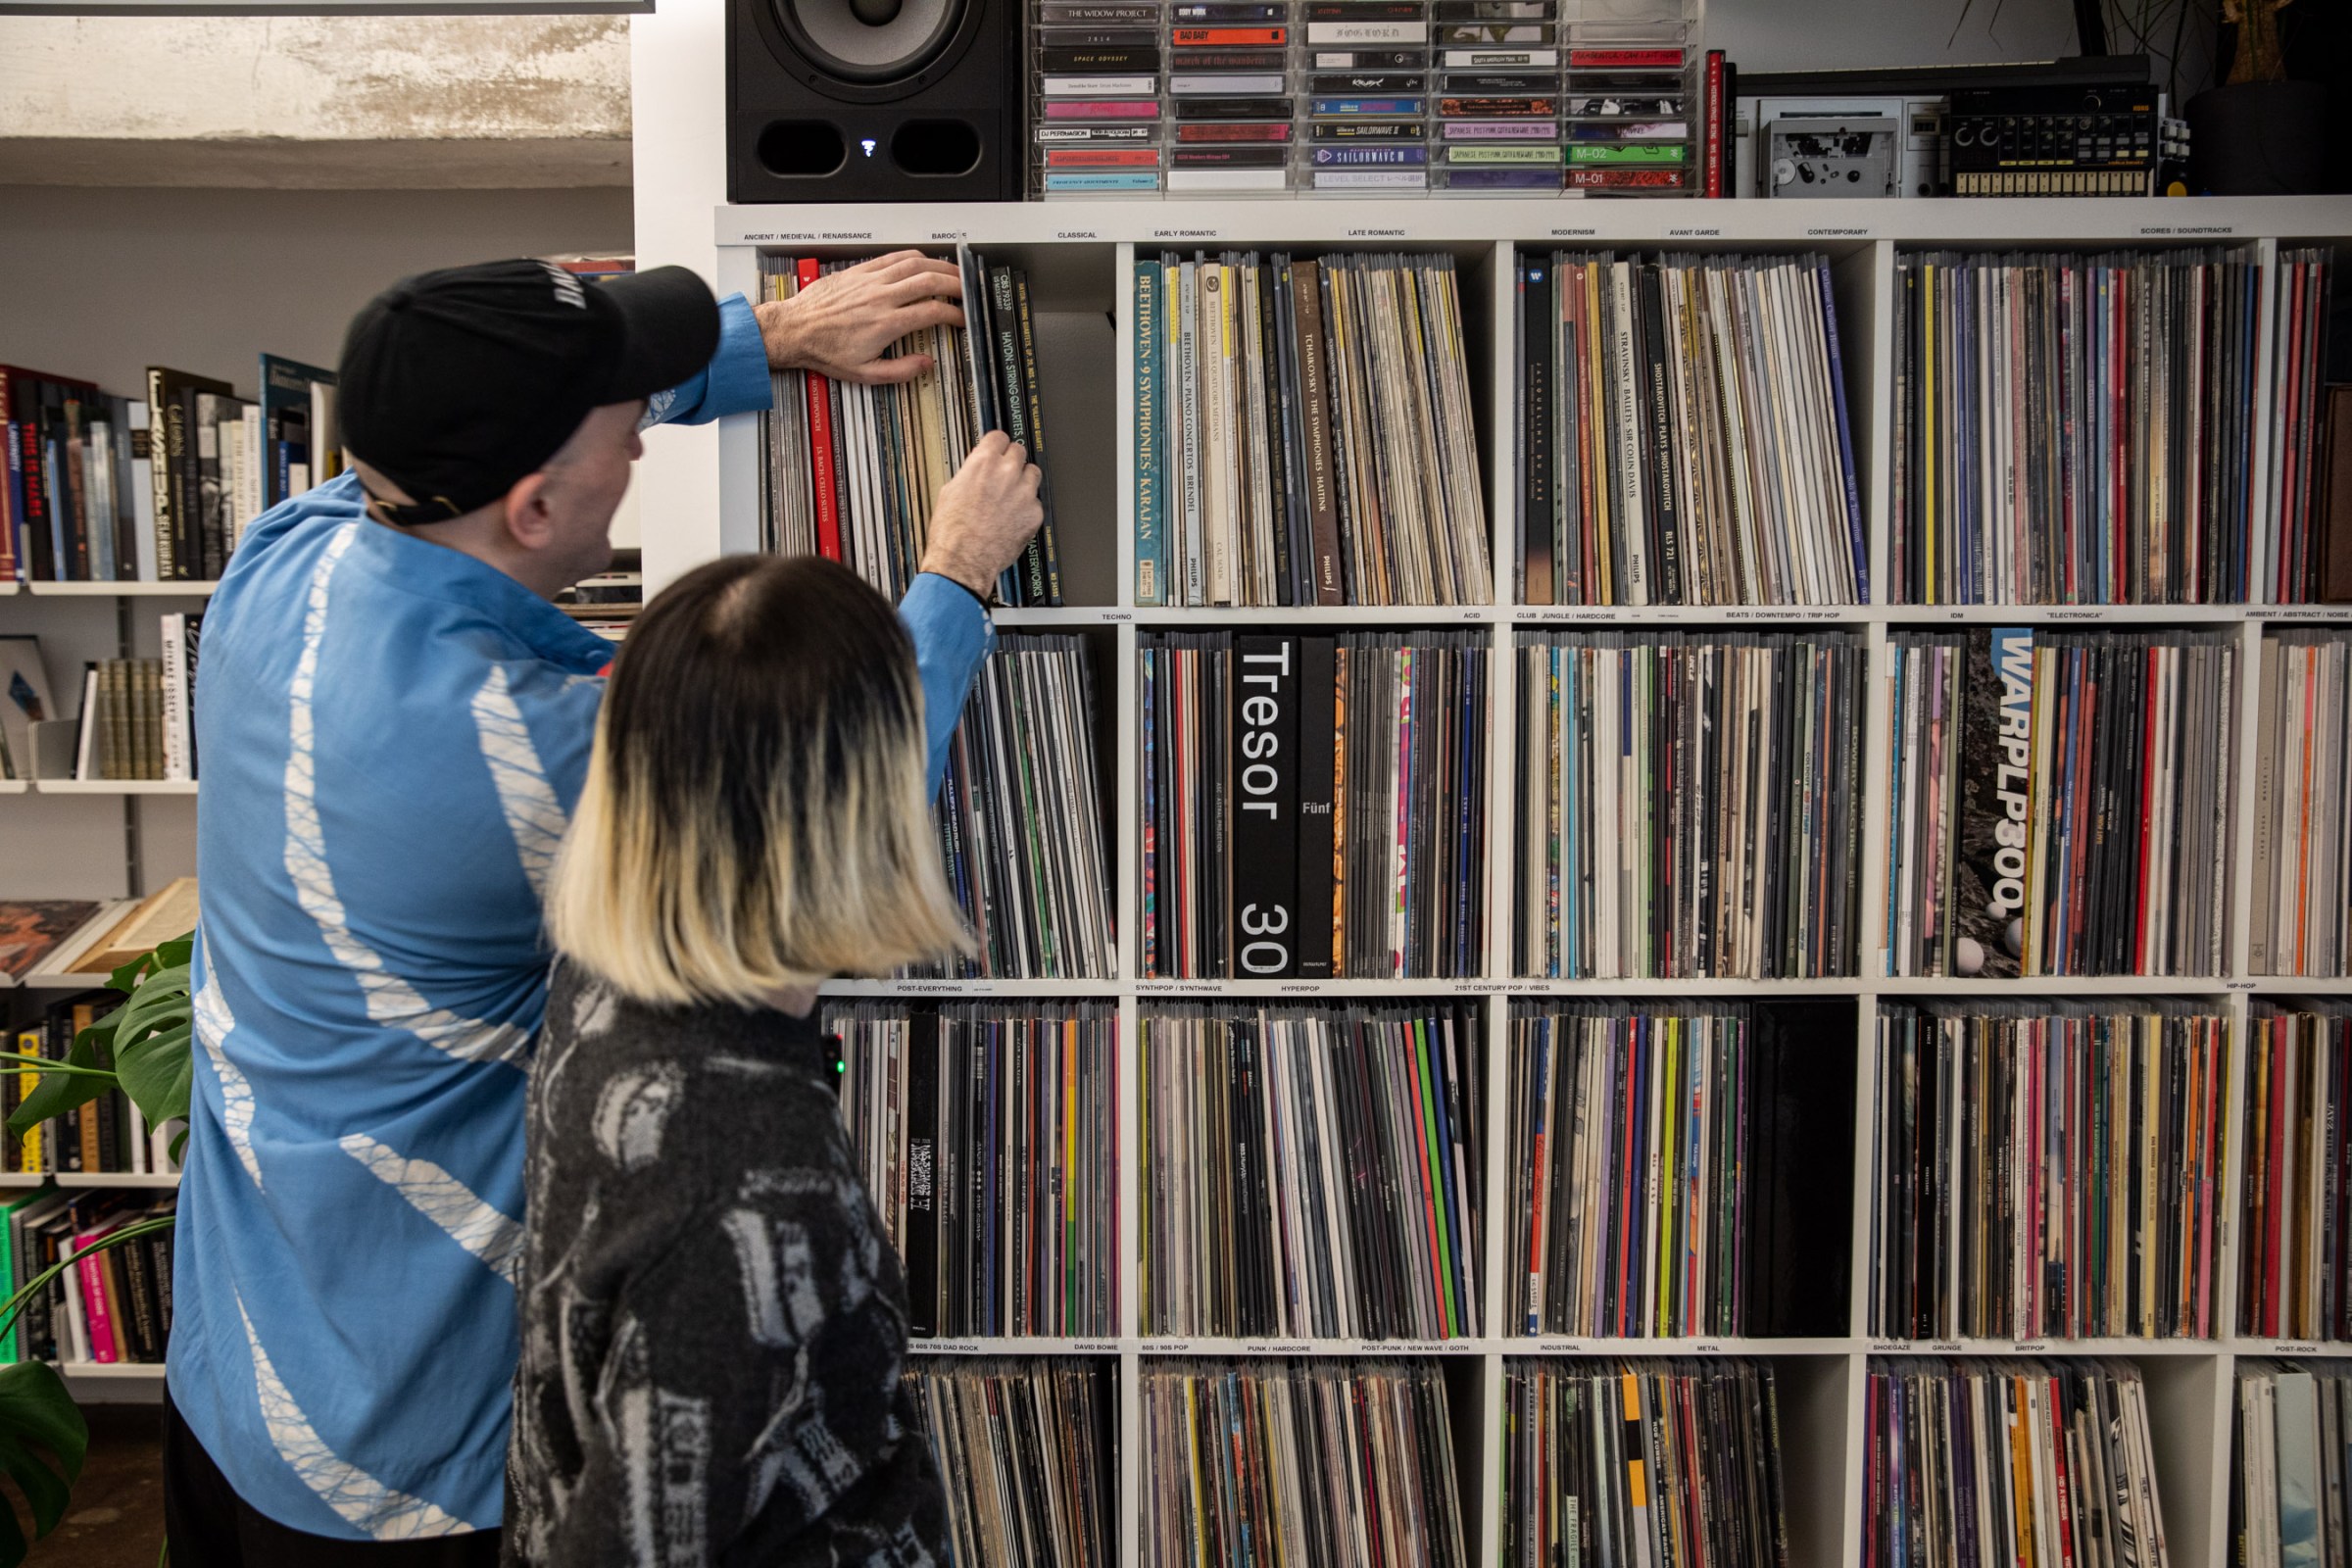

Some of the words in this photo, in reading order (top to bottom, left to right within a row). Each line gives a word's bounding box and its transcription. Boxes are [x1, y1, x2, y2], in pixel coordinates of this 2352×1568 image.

[1577, 149, 1606, 159] M-02
[1576, 173, 1602, 183] M-01
[1002, 290, 1011, 311] 79339
[1140, 275, 1152, 359] BEETHOVEN
[1002, 332, 1014, 364] HAYDN:
[1305, 334, 1317, 393] TCHAIKOVSKY
[1621, 331, 1632, 383] STRAVINSKY
[1005, 366, 1018, 394] STRING
[1655, 363, 1665, 423] SHOSTAKOVITCH
[811, 380, 821, 431] ROSTROPOVICH
[1141, 376, 1152, 469] SYMPHONIES
[1624, 389, 1634, 423] BALLETS
[22, 423, 35, 456] THIS
[1311, 416, 1323, 471] SYMPHONIES
[1626, 429, 1635, 443] SIR
[1658, 426, 1667, 449] PLAYS
[1627, 445, 1636, 471] COLIN
[26, 476, 41, 516] MARS
[818, 477, 827, 498] CELLO
[1316, 476, 1327, 512] HAITINK
[1628, 473, 1637, 498] DAVIS
[1660, 451, 1672, 511] SHOSTAKOVITCH
[820, 500, 829, 521] SUITES
[1141, 478, 1152, 539] KARAJAN
[1665, 531, 1674, 546] RLS
[1323, 556, 1332, 585] PHILIPS
[1243, 642, 1289, 820] Tresor
[1993, 636, 2033, 908] WARPLP300
[1303, 803, 1330, 813] Fünf
[1849, 793, 1858, 858] ELECTRIC
[1242, 903, 1288, 973] 30
